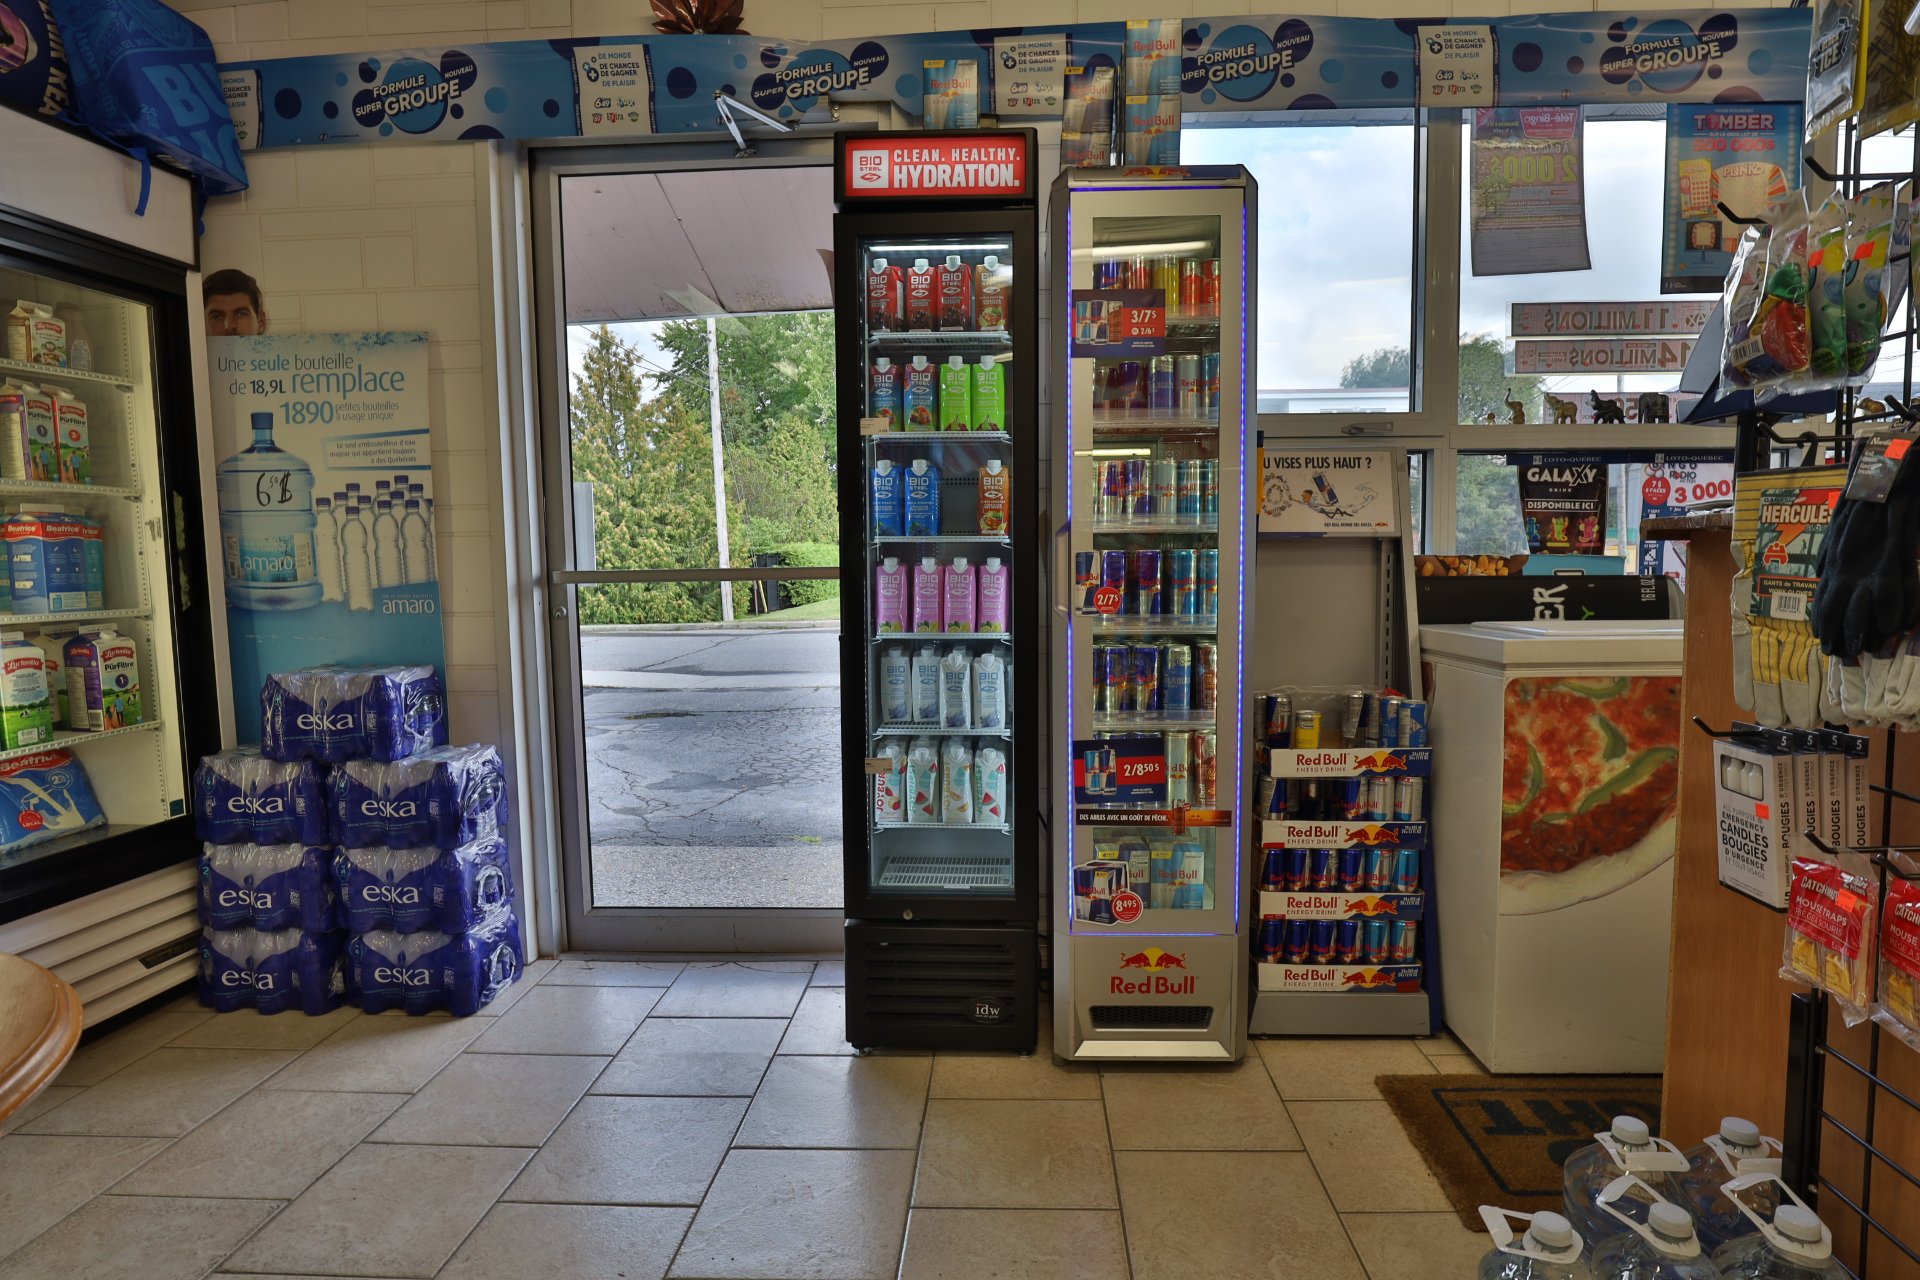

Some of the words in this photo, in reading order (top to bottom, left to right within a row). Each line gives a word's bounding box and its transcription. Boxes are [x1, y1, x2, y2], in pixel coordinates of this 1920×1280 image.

[1134, 40, 1154, 51] Red
[1155, 39, 1176, 50] Bull
[1276, 34, 1310, 50] NOUVEAU
[1702, 30, 1734, 43] NOUVEAU
[1197, 43, 1256, 65] FORMULE
[1624, 36, 1682, 56] FORMULE
[608, 52, 632, 60] MONDE
[853, 54, 886, 67] NOUVEAU
[1635, 42, 1723, 74] GROUPE
[444, 64, 474, 80] NOUVEAU
[610, 62, 640, 70] CHANCES
[775, 62, 832, 83] FORMULE
[1208, 50, 1293, 82] GROUPE
[1602, 58, 1634, 73] SUPER
[786, 66, 870, 99] GROUPE
[1182, 69, 1206, 80] UPER
[372, 74, 425, 98] FORMULE
[754, 86, 784, 98] SUPER
[384, 79, 461, 116] GROUPE
[355, 100, 382, 117] SUPER
[1132, 116, 1154, 126] Red
[1154, 114, 1175, 126] Bull
[1694, 114, 1775, 130] TOMBER
[860, 156, 882, 166] BIO
[894, 149, 945, 162] CLEAN.
[952, 148, 1020, 162] HEALTHY.
[894, 164, 1020, 189] HYDRATION.
[910, 276, 930, 284] BIO
[218, 358, 246, 372] Une
[251, 356, 290, 371] seule
[295, 353, 354, 370] bouteille
[230, 380, 246, 395] de
[250, 380, 286, 397] 18,9L
[292, 364, 404, 399] remplace
[280, 401, 334, 425] 1890
[336, 402, 361, 413] petites
[362, 402, 399, 411] bouteilles
[342, 413, 366, 422] usage
[368, 411, 394, 422] unique
[362, 449, 391, 457] appartient
[393, 448, 416, 456] toujours
[387, 455, 416, 464] Québécois
[1264, 457, 1270, 469] U
[1274, 457, 1301, 469] VISES
[1305, 457, 1330, 469] PLUS
[1334, 457, 1362, 469] HAUT
[1365, 457, 1372, 469] ?
[1527, 464, 1598, 486] GALAXY
[1674, 486, 1687, 503] 3
[1528, 501, 1580, 509] DISPONIBLE
[1582, 501, 1594, 509] ICI
[243, 556, 294, 572] amaro
[382, 600, 434, 614] amaro
[1097, 594, 1118, 605] 2/7$
[296, 713, 354, 730] eska
[1297, 754, 1321, 766] Red
[1322, 753, 1347, 765] Bull
[876, 772, 885, 812] JOYBUR
[228, 796, 284, 814] eska
[361, 800, 417, 817] eska
[23, 820, 42, 828] LOCAL
[1722, 812, 1764, 833] EMERGENCY
[1288, 826, 1312, 838] Red
[1314, 826, 1338, 837] Bull
[1720, 820, 1769, 848] CANDLES
[1722, 833, 1768, 862] BOUGIES
[1725, 848, 1765, 871] D'URGENCE
[219, 889, 272, 909] eska
[362, 885, 419, 904] eska
[1796, 896, 1823, 913] MOUSE
[1823, 909, 1848, 926] TRAPS
[221, 970, 274, 990] eska
[374, 967, 430, 985] eska
[1111, 976, 1152, 994] Red
[1155, 976, 1195, 994] Bull
[975, 1003, 1000, 1015] idw
